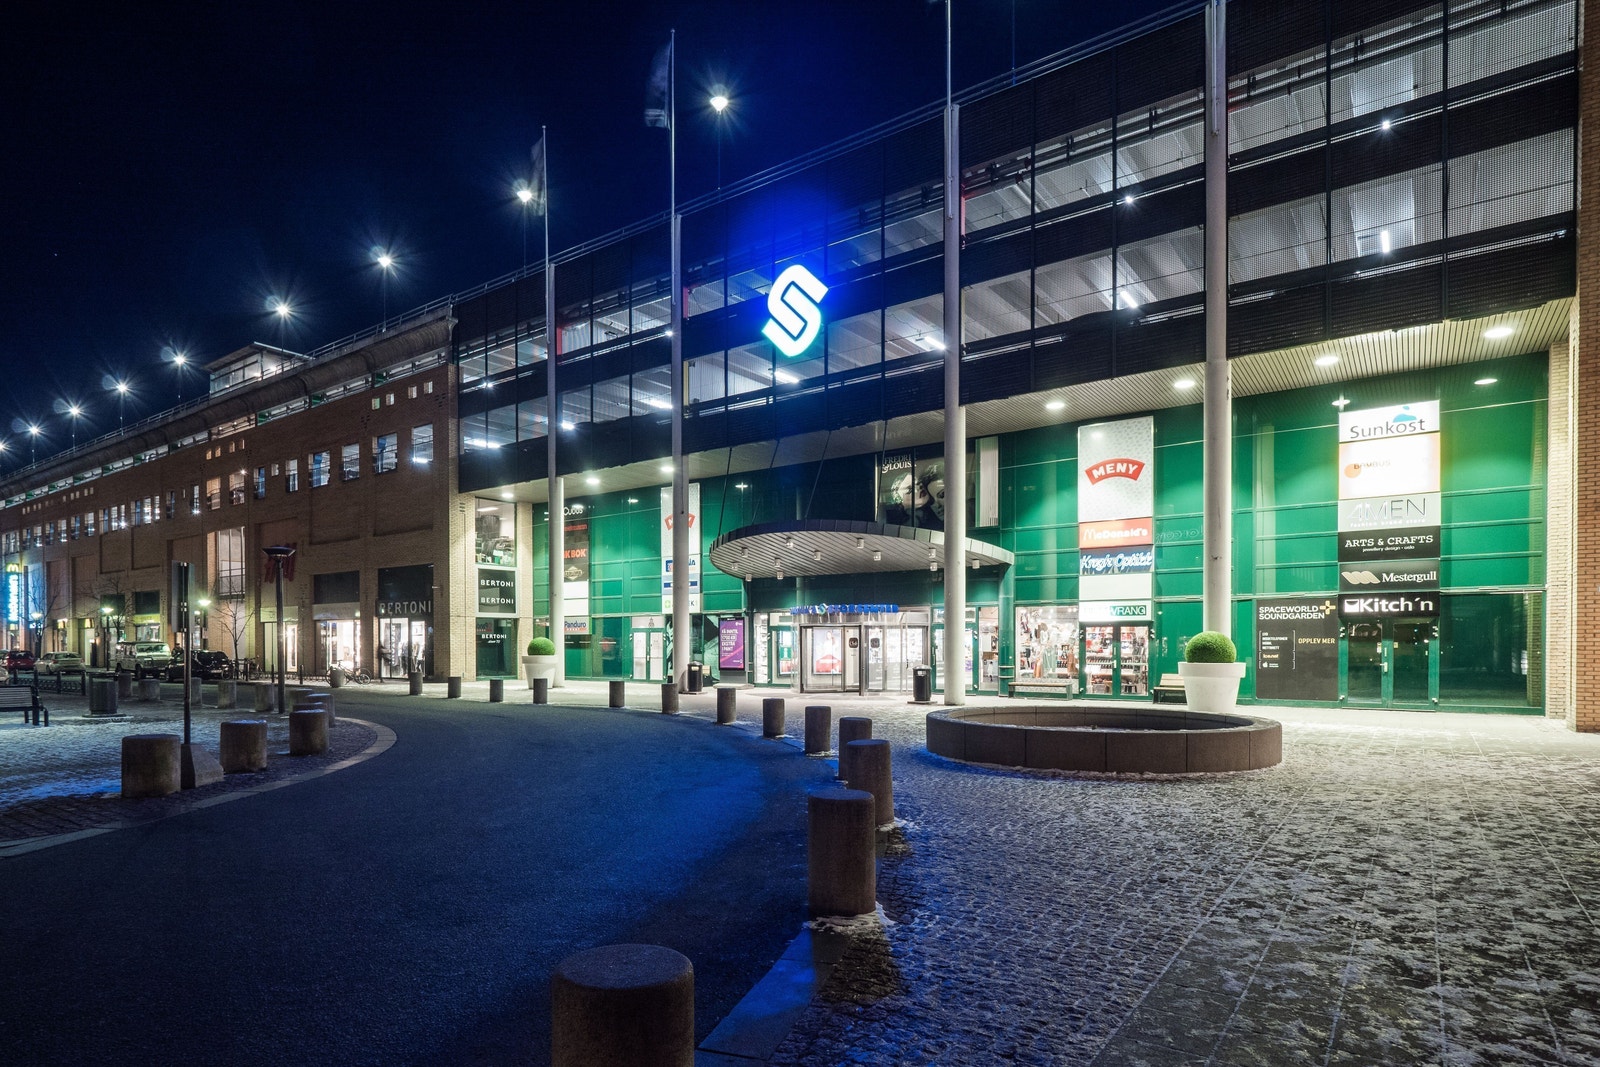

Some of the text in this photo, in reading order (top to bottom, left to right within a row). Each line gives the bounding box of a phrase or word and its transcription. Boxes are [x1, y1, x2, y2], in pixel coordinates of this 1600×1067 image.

[1350, 418, 1426, 439] Sunkost
[884, 454, 917, 464] FREDRI
[1091, 462, 1139, 480] MENY
[1345, 535, 1433, 548] ARTS & CRAFTS
[571, 548, 586, 557] BOK
[1382, 571, 1437, 583] Mestergull
[480, 579, 514, 587] BERTONI
[380, 600, 431, 614] BERTONI
[1259, 605, 1319, 614] SPACEWORLD
[1358, 597, 1433, 613] Kitch'n
[1259, 612, 1325, 620] SOUNDGARDEN
[564, 620, 587, 628] Panduro
